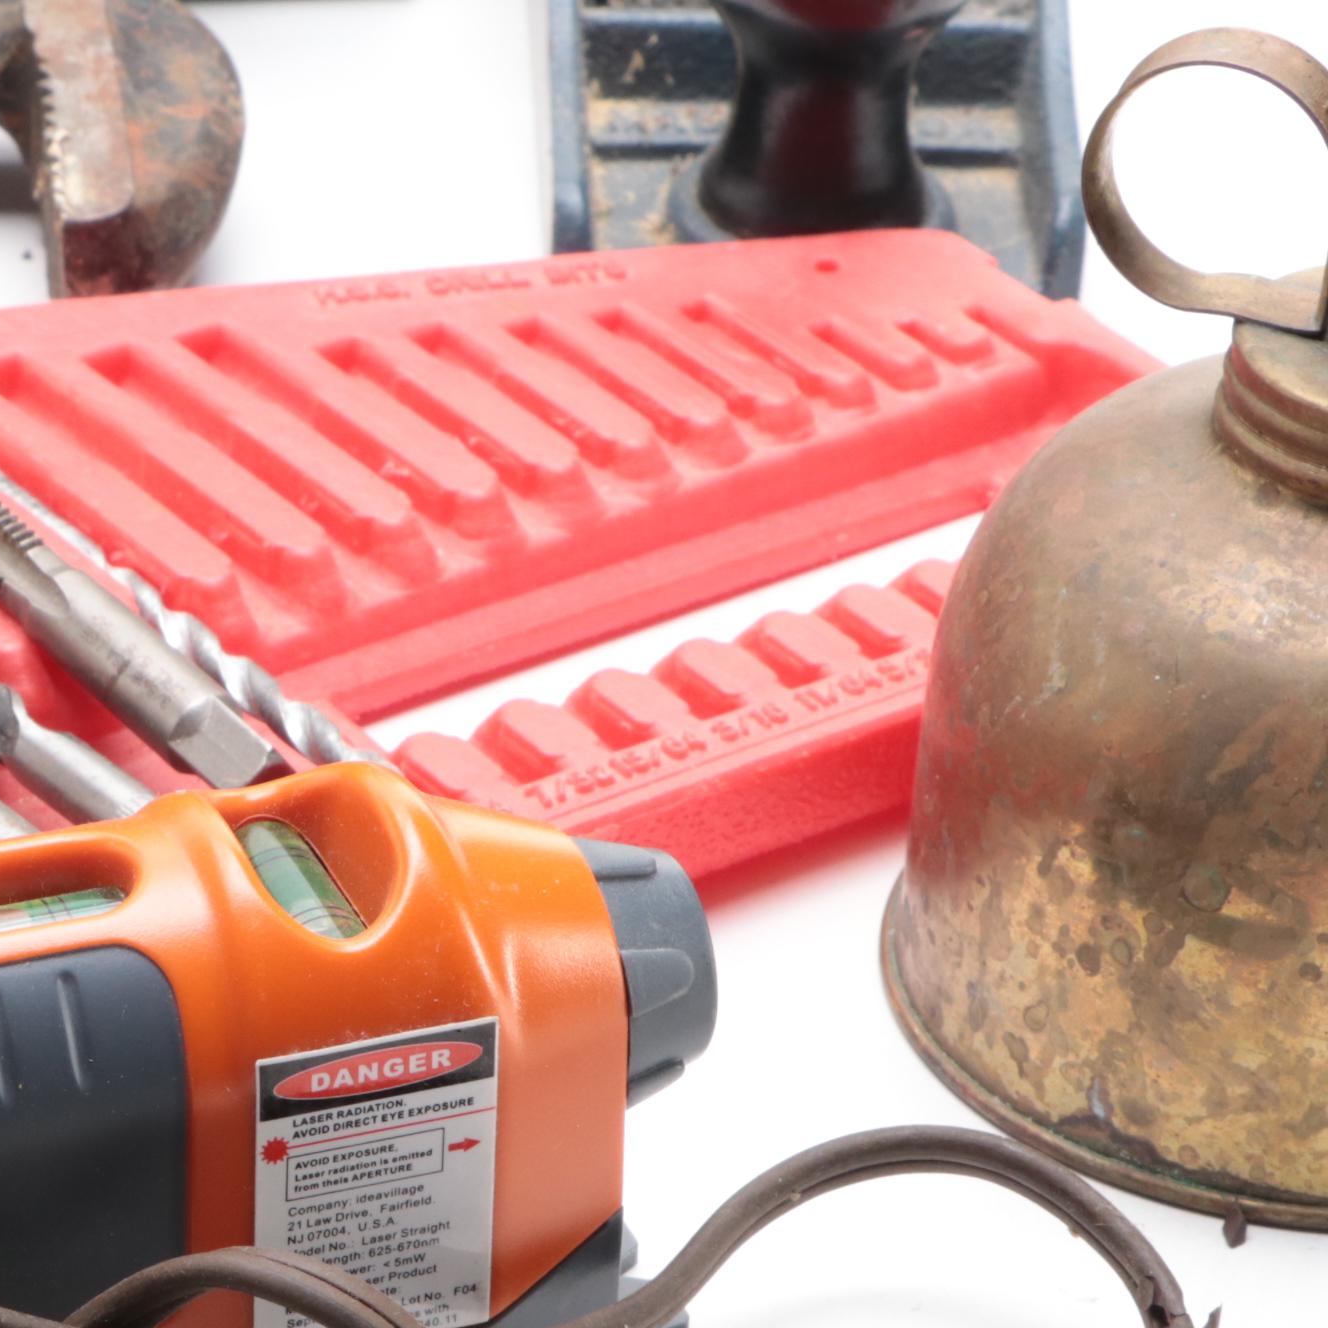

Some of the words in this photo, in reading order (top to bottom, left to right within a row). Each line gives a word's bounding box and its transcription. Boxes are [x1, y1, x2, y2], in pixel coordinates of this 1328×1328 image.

[312, 1049, 450, 1091] DANGER
[292, 1125, 329, 1139] AVOID
[333, 1115, 377, 1132] DIRECT
[381, 1111, 404, 1122] EYE
[408, 1097, 473, 1117] EXPOSURE
[293, 1113, 333, 1128] LASER
[295, 1157, 329, 1170] AVOID
[295, 1171, 325, 1182] Laser
[328, 1161, 376, 1175] radiation
[380, 1158, 390, 1166] is
[392, 1148, 433, 1164] emitted
[294, 1183, 319, 1192] from
[352, 1164, 411, 1182] APERTURE
[356, 1185, 424, 1203] ideavillage
[288, 1221, 302, 1233] 21
[307, 1217, 332, 1228] Law
[362, 1232, 397, 1246] Laser
[401, 1221, 450, 1238] Straight
[288, 1234, 304, 1246] NJ
[368, 1239, 439, 1258] 625-670nm
[395, 1253, 425, 1267] 5mW
[388, 1264, 437, 1281] Product
[401, 1294, 421, 1305] Lot
